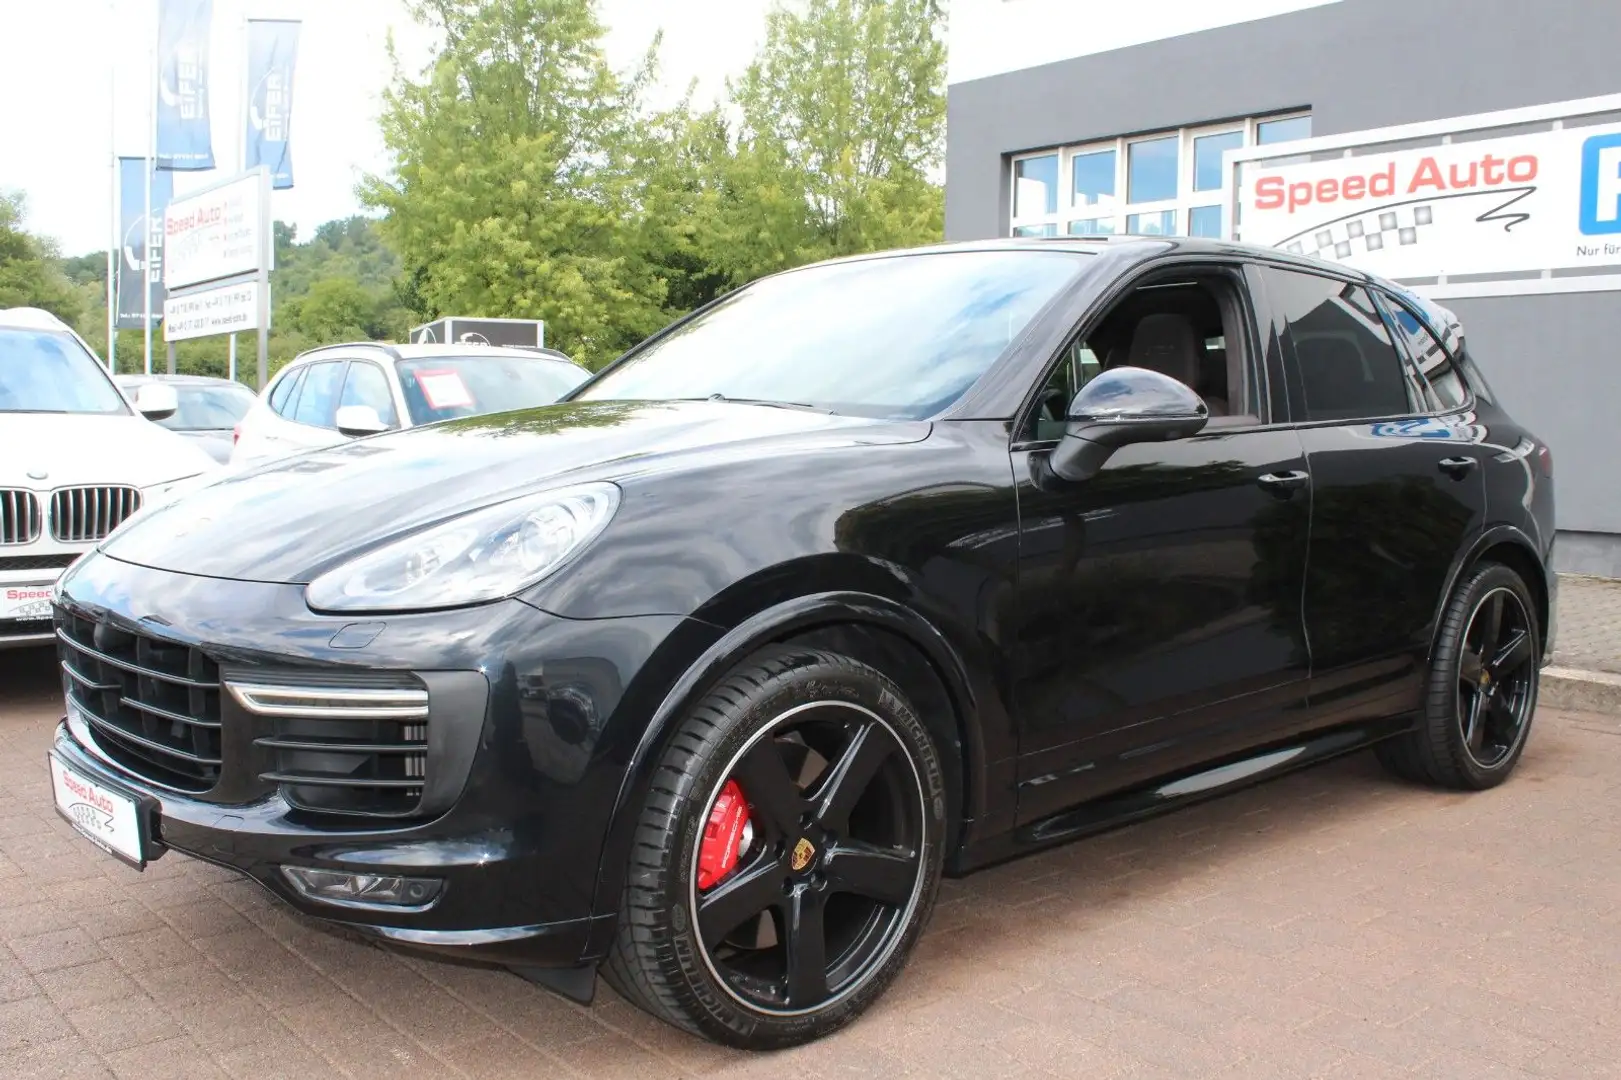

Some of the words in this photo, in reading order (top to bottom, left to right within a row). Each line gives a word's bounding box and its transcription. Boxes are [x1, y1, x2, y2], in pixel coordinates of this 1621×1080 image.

[1254, 161, 1396, 214] Speed
[1407, 154, 1539, 194] Auto
[166, 210, 195, 236] Speed
[197, 205, 221, 227] Auto
[1576, 246, 1600, 257] Nur
[1604, 243, 1621, 255] für
[89, 786, 113, 814] Auto
